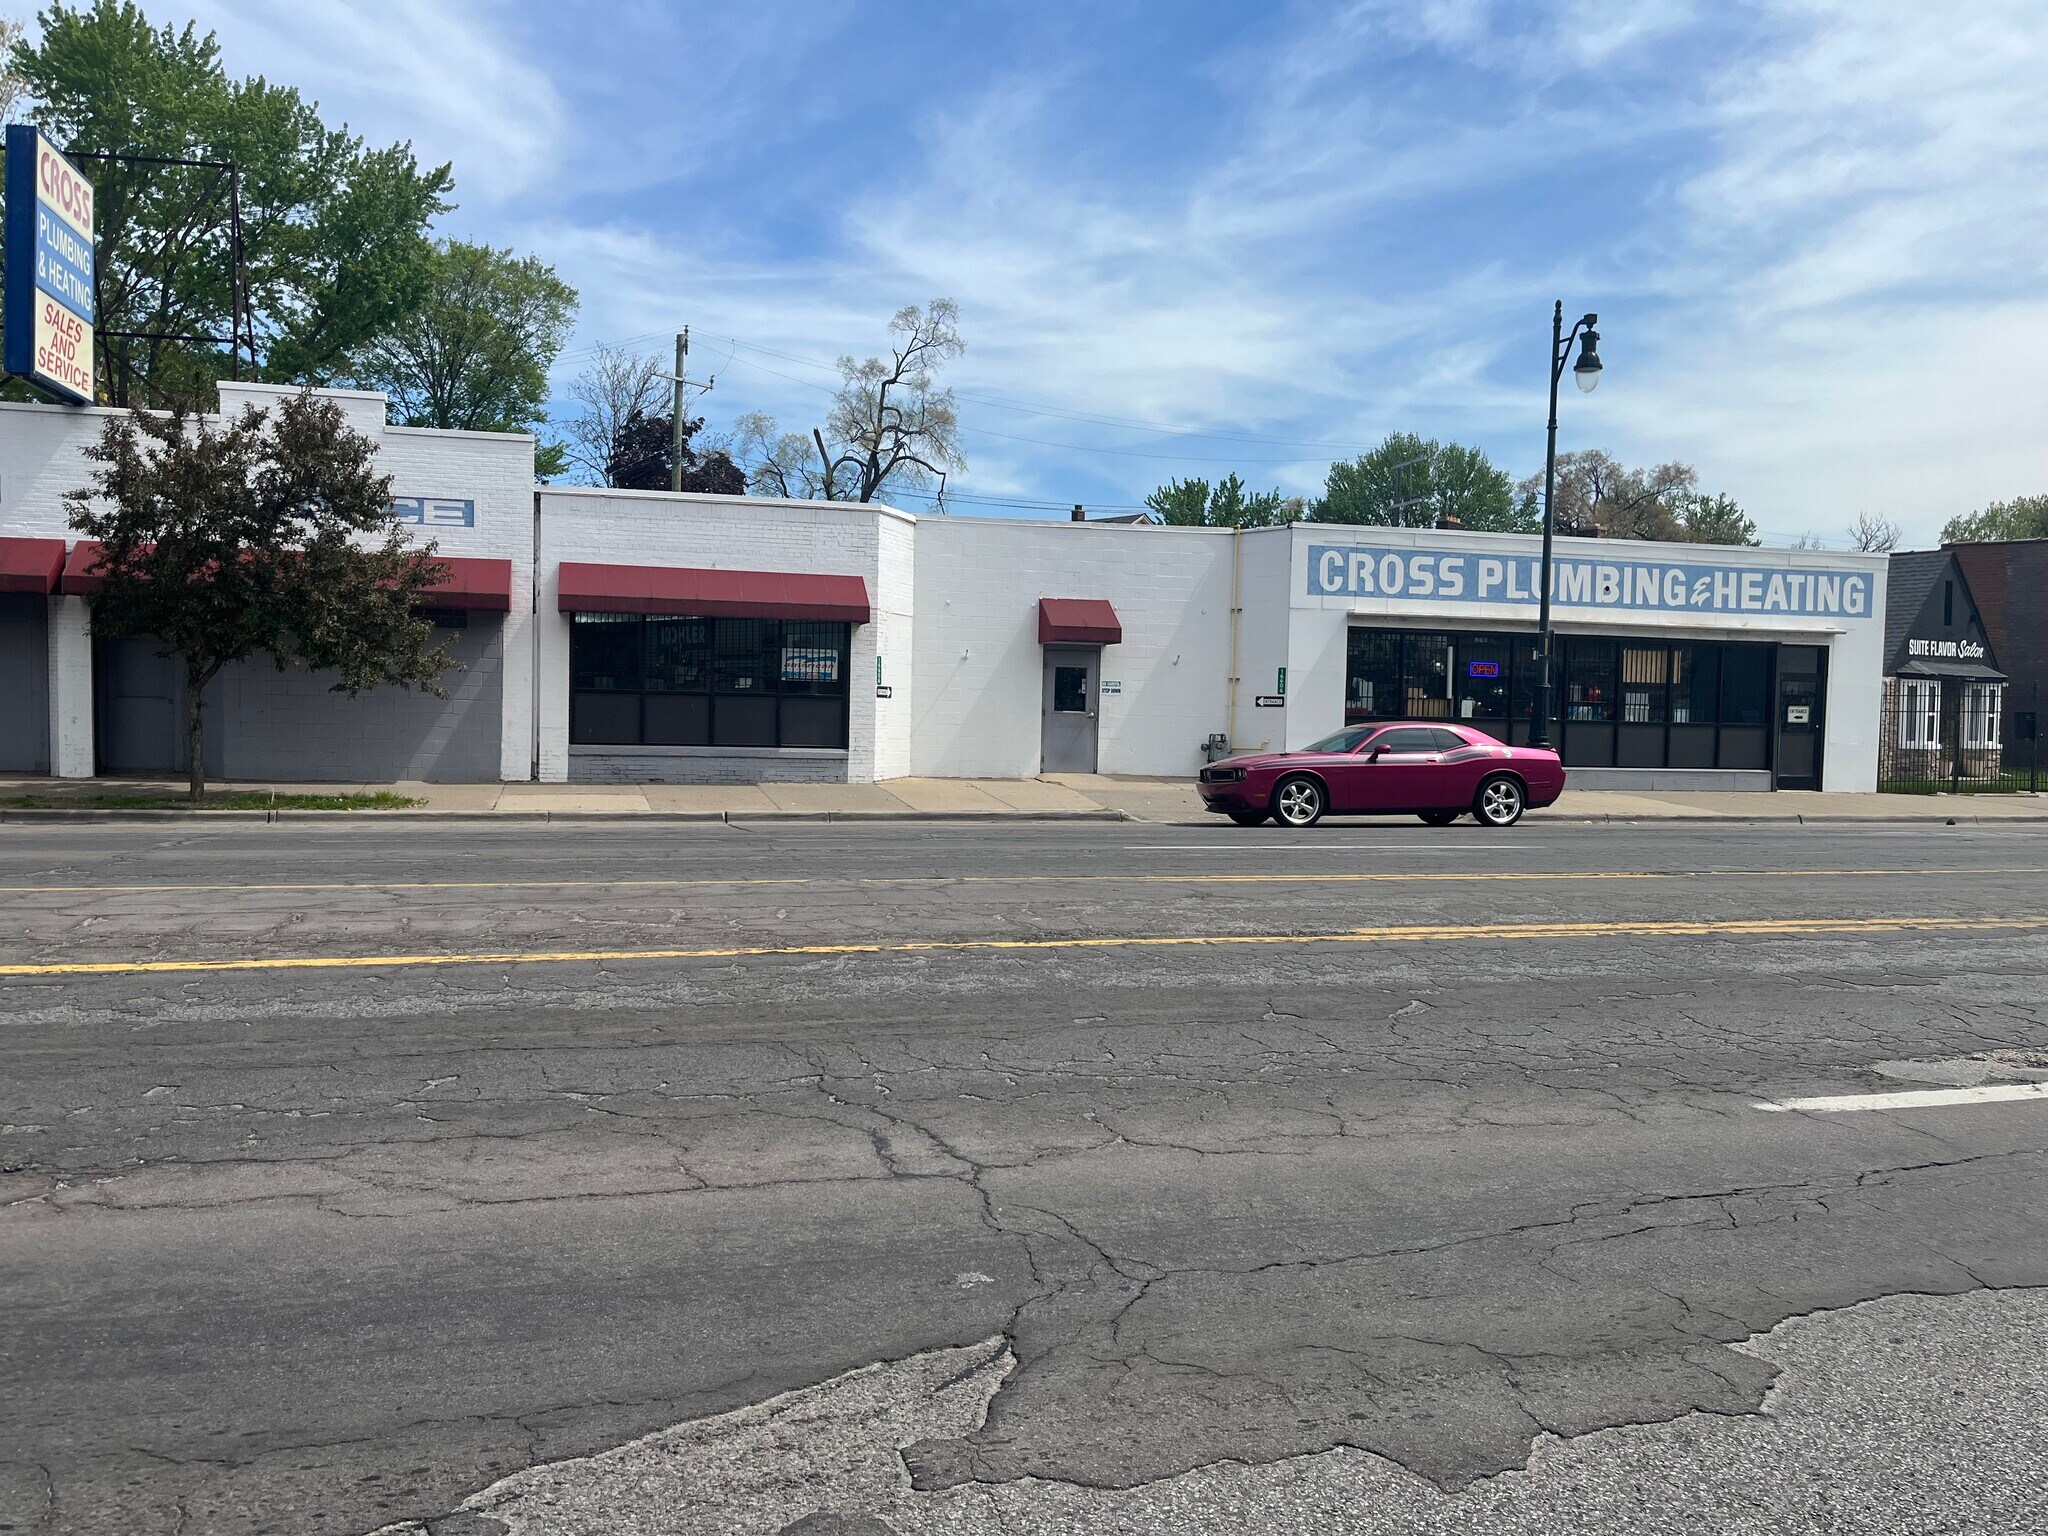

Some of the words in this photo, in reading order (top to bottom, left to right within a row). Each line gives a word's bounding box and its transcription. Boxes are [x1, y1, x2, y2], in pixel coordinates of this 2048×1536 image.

[41, 152, 91, 230] CROSS
[40, 212, 91, 276] PLUMBING
[38, 250, 46, 279] &
[49, 258, 92, 312] HEATING
[44, 302, 83, 344] SALES
[51, 332, 76, 361] AND
[38, 346, 89, 392] SERVICE
[1319, 550, 1464, 596] CROSS
[1478, 558, 1687, 607] PLUMBING
[1713, 571, 1866, 615] HEATING
[660, 625, 706, 645] KOHLER
[1909, 639, 1929, 656] SUITE
[1930, 640, 1957, 657] FLAVOR
[1957, 640, 1985, 659] Salon
[1472, 664, 1497, 675] OPEN
